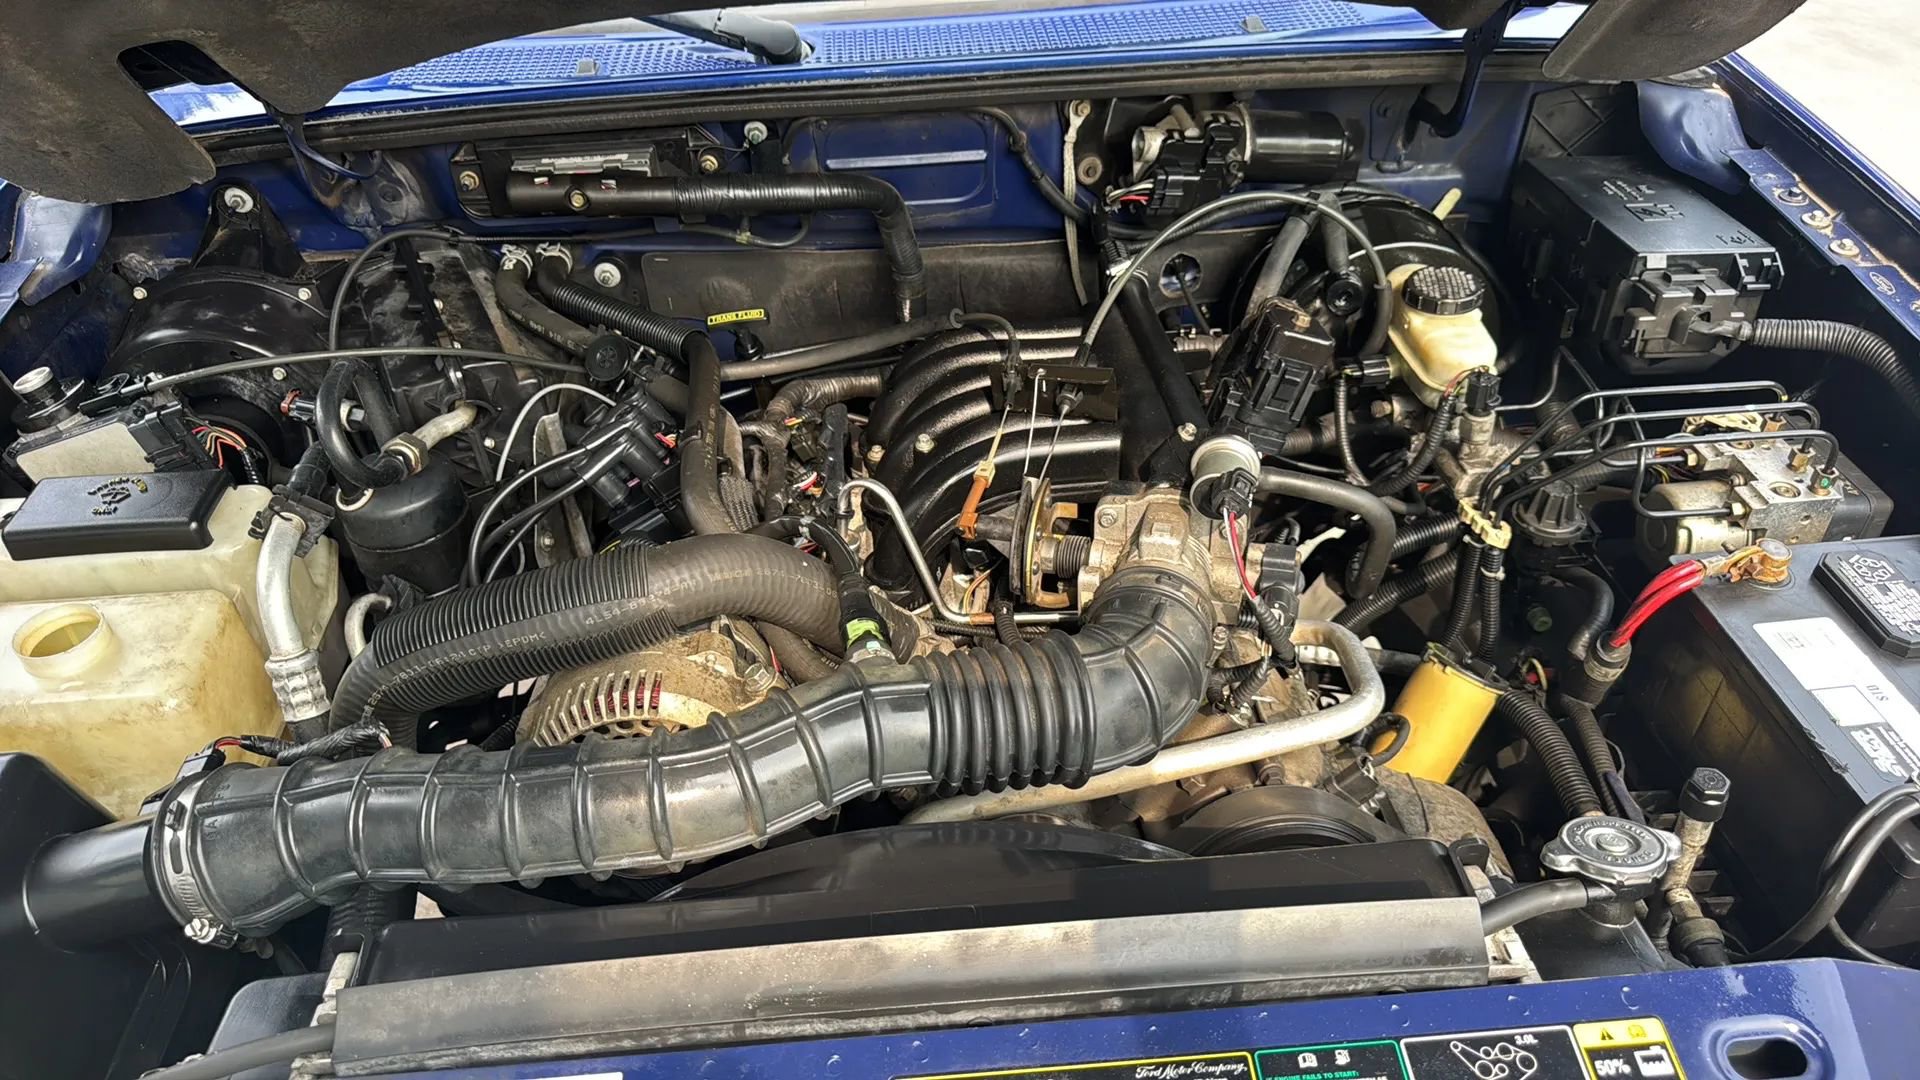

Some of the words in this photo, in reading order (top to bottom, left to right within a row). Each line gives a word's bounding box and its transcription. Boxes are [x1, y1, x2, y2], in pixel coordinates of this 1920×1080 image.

[709, 312, 737, 323] TRANS
[738, 310, 763, 320] FLUID
[1513, 1033, 1539, 1045] 3.0L
[1135, 1065, 1163, 1079] Ford
[1160, 1063, 1193, 1079] Motor
[1191, 1061, 1248, 1075] Company
[1594, 1058, 1632, 1076] 50%
